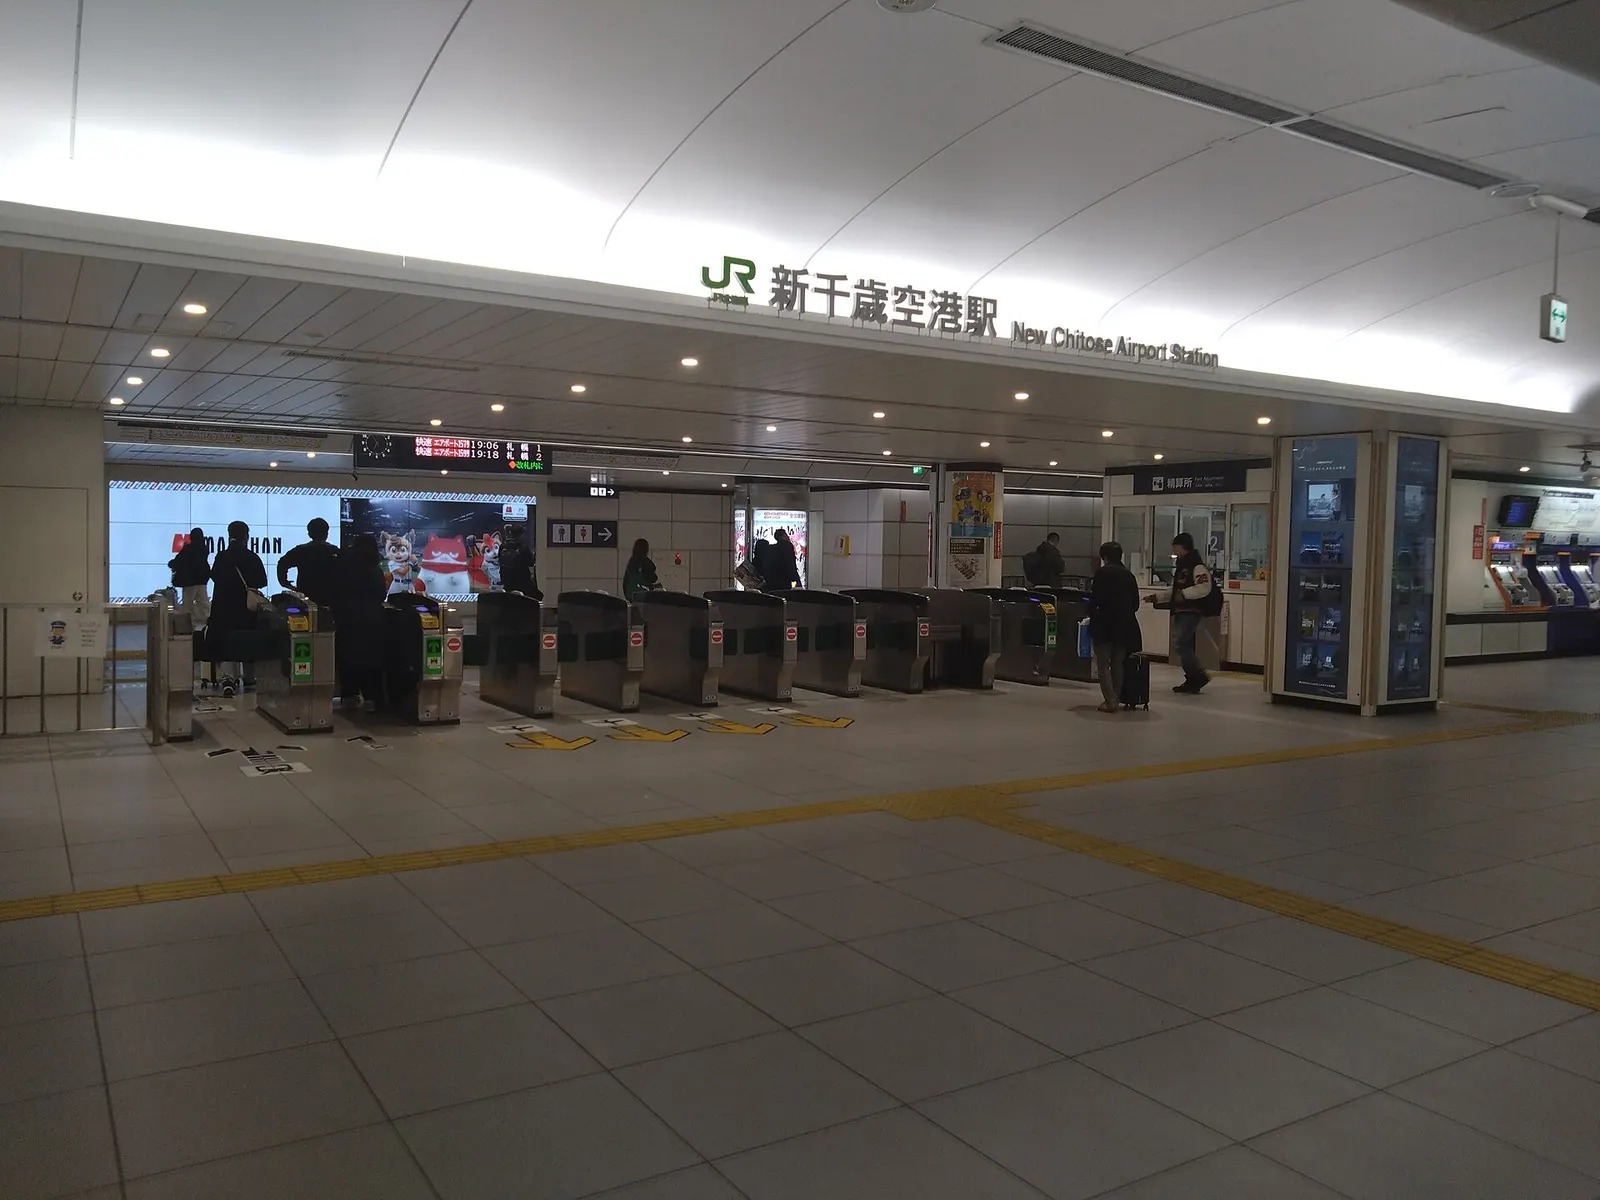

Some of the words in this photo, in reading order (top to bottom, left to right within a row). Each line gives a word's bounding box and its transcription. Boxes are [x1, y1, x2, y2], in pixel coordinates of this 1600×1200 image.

[702, 256, 756, 293] JR
[769, 264, 998, 338] 新千歳空港駅
[1011, 321, 1047, 345] New
[1051, 327, 1113, 354] Chitose
[1114, 336, 1168, 364] Airport
[1169, 343, 1219, 368] Station
[471, 441, 499, 450] 19:06
[471, 449, 499, 459] 19:18
[535, 452, 542, 461] 2
[1167, 477, 1192, 489] 精算所
[203, 536, 282, 554] MAHAN
